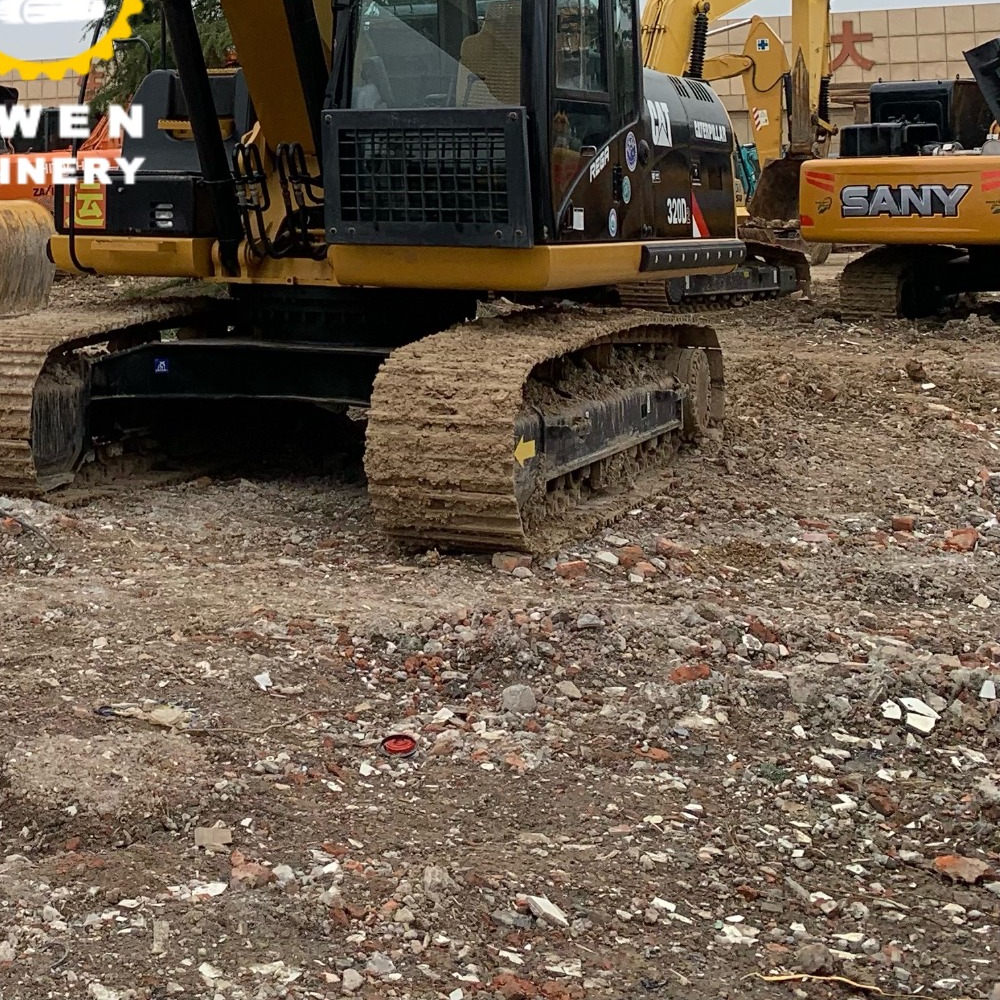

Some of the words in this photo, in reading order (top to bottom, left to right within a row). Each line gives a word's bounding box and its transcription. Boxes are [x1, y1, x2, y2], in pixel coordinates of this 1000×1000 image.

[829, 20, 876, 72] 大
[647, 100, 673, 148] CAT
[693, 119, 728, 143] CATERPILLAR
[589, 145, 610, 183] REGA
[840, 184, 972, 218] SANY
